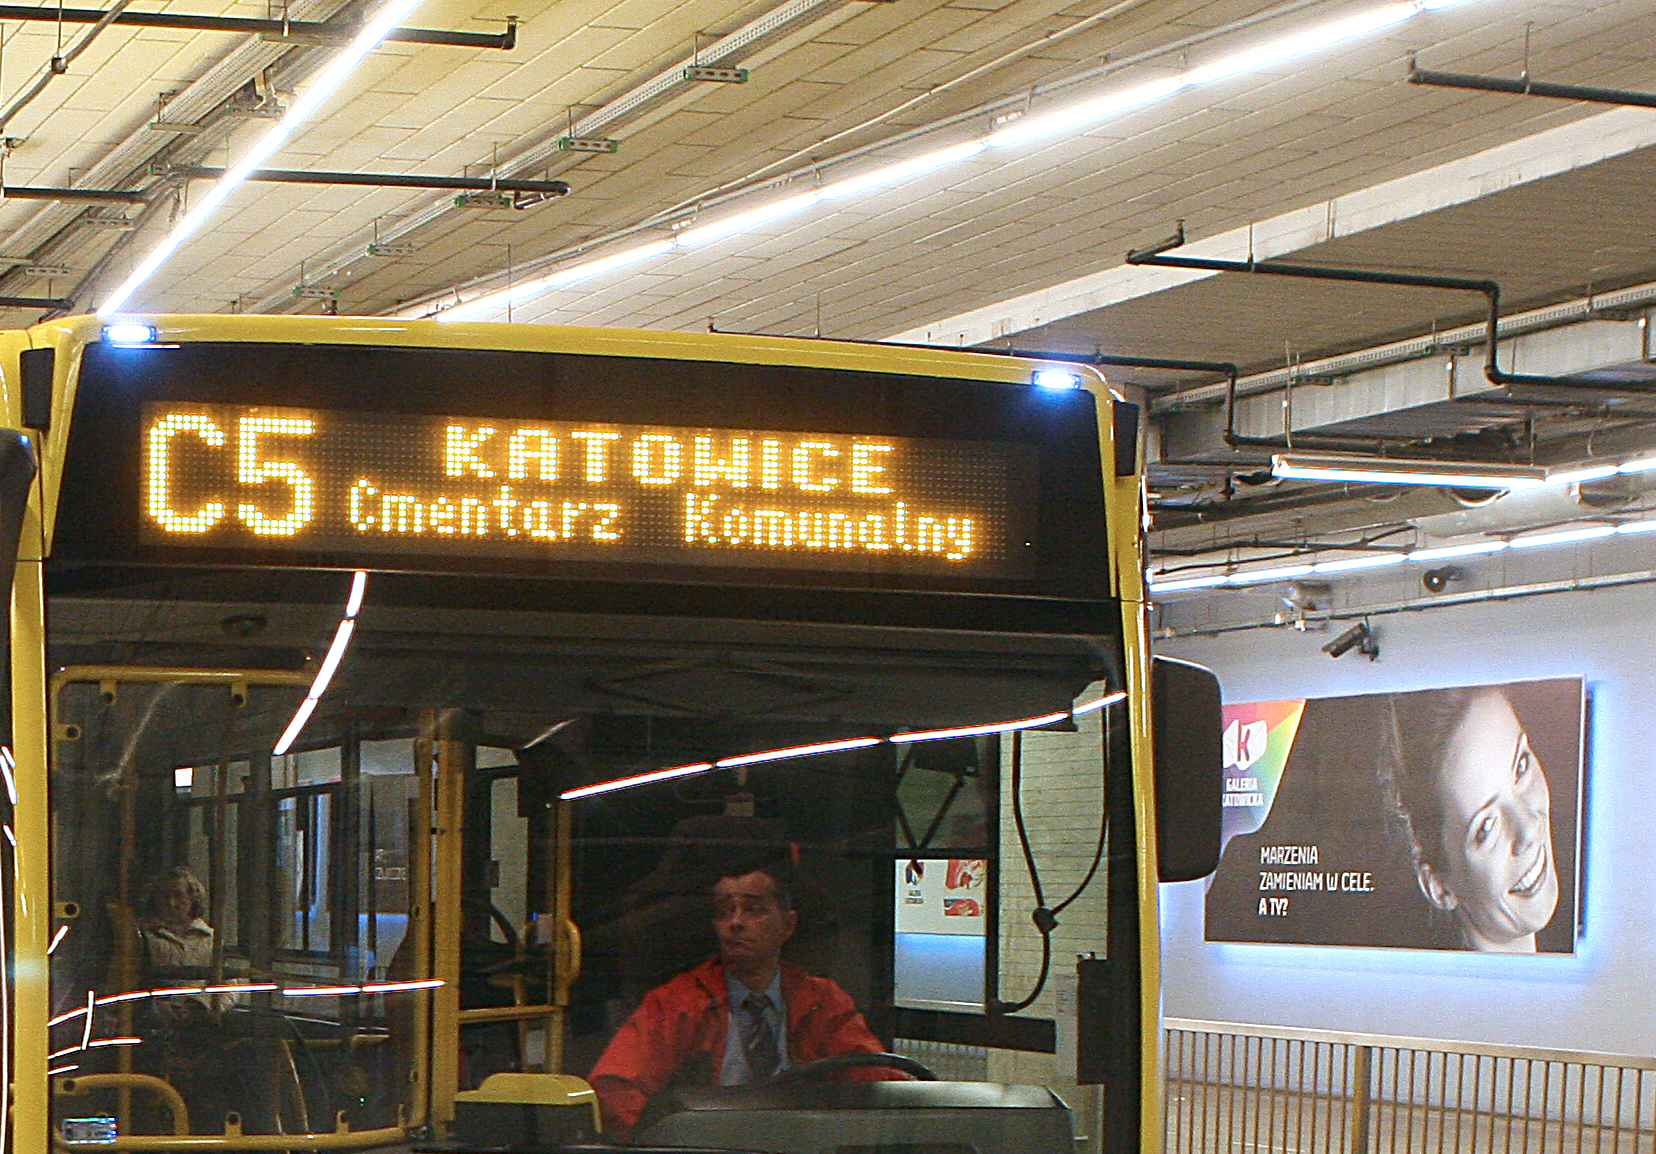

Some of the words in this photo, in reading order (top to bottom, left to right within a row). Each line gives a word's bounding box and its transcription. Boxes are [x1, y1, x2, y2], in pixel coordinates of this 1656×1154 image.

[148, 413, 315, 536] C5
[445, 424, 893, 494] KATOWICE
[349, 478, 622, 540] Cmentarz
[684, 491, 974, 560] Komunalny
[1261, 845, 1319, 865] MARZENIA
[1259, 871, 1324, 891] ZAMIENIAM
[1326, 872, 1339, 892] W
[1341, 871, 1375, 892] CELE.
[1258, 897, 1268, 916] A
[1269, 897, 1289, 916] TY?
